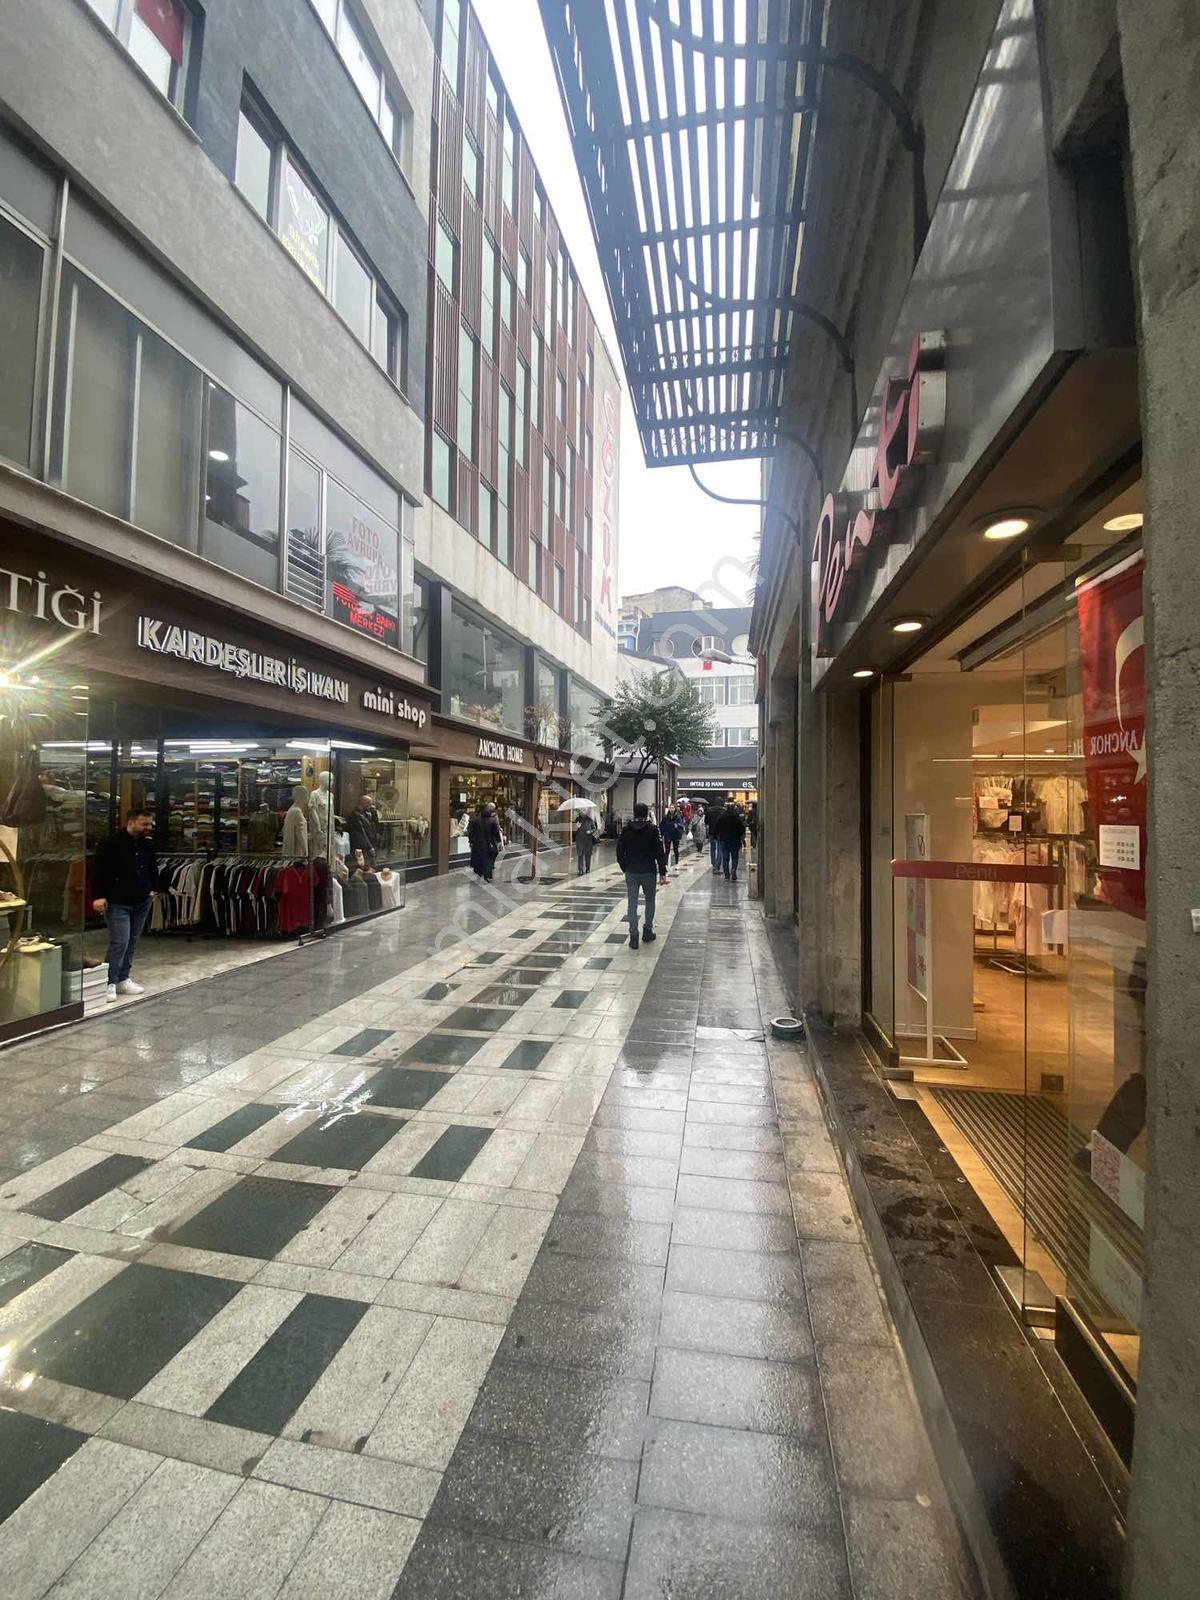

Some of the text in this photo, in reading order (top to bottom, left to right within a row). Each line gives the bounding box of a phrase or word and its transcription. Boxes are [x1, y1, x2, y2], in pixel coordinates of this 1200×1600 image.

[352, 516, 380, 550] FOTO
[138, 616, 287, 686] KARDEŞLER
[307, 671, 349, 704] HANI
[363, 687, 426, 728] mini shop
[478, 738, 523, 763] ANCHOR HOME
